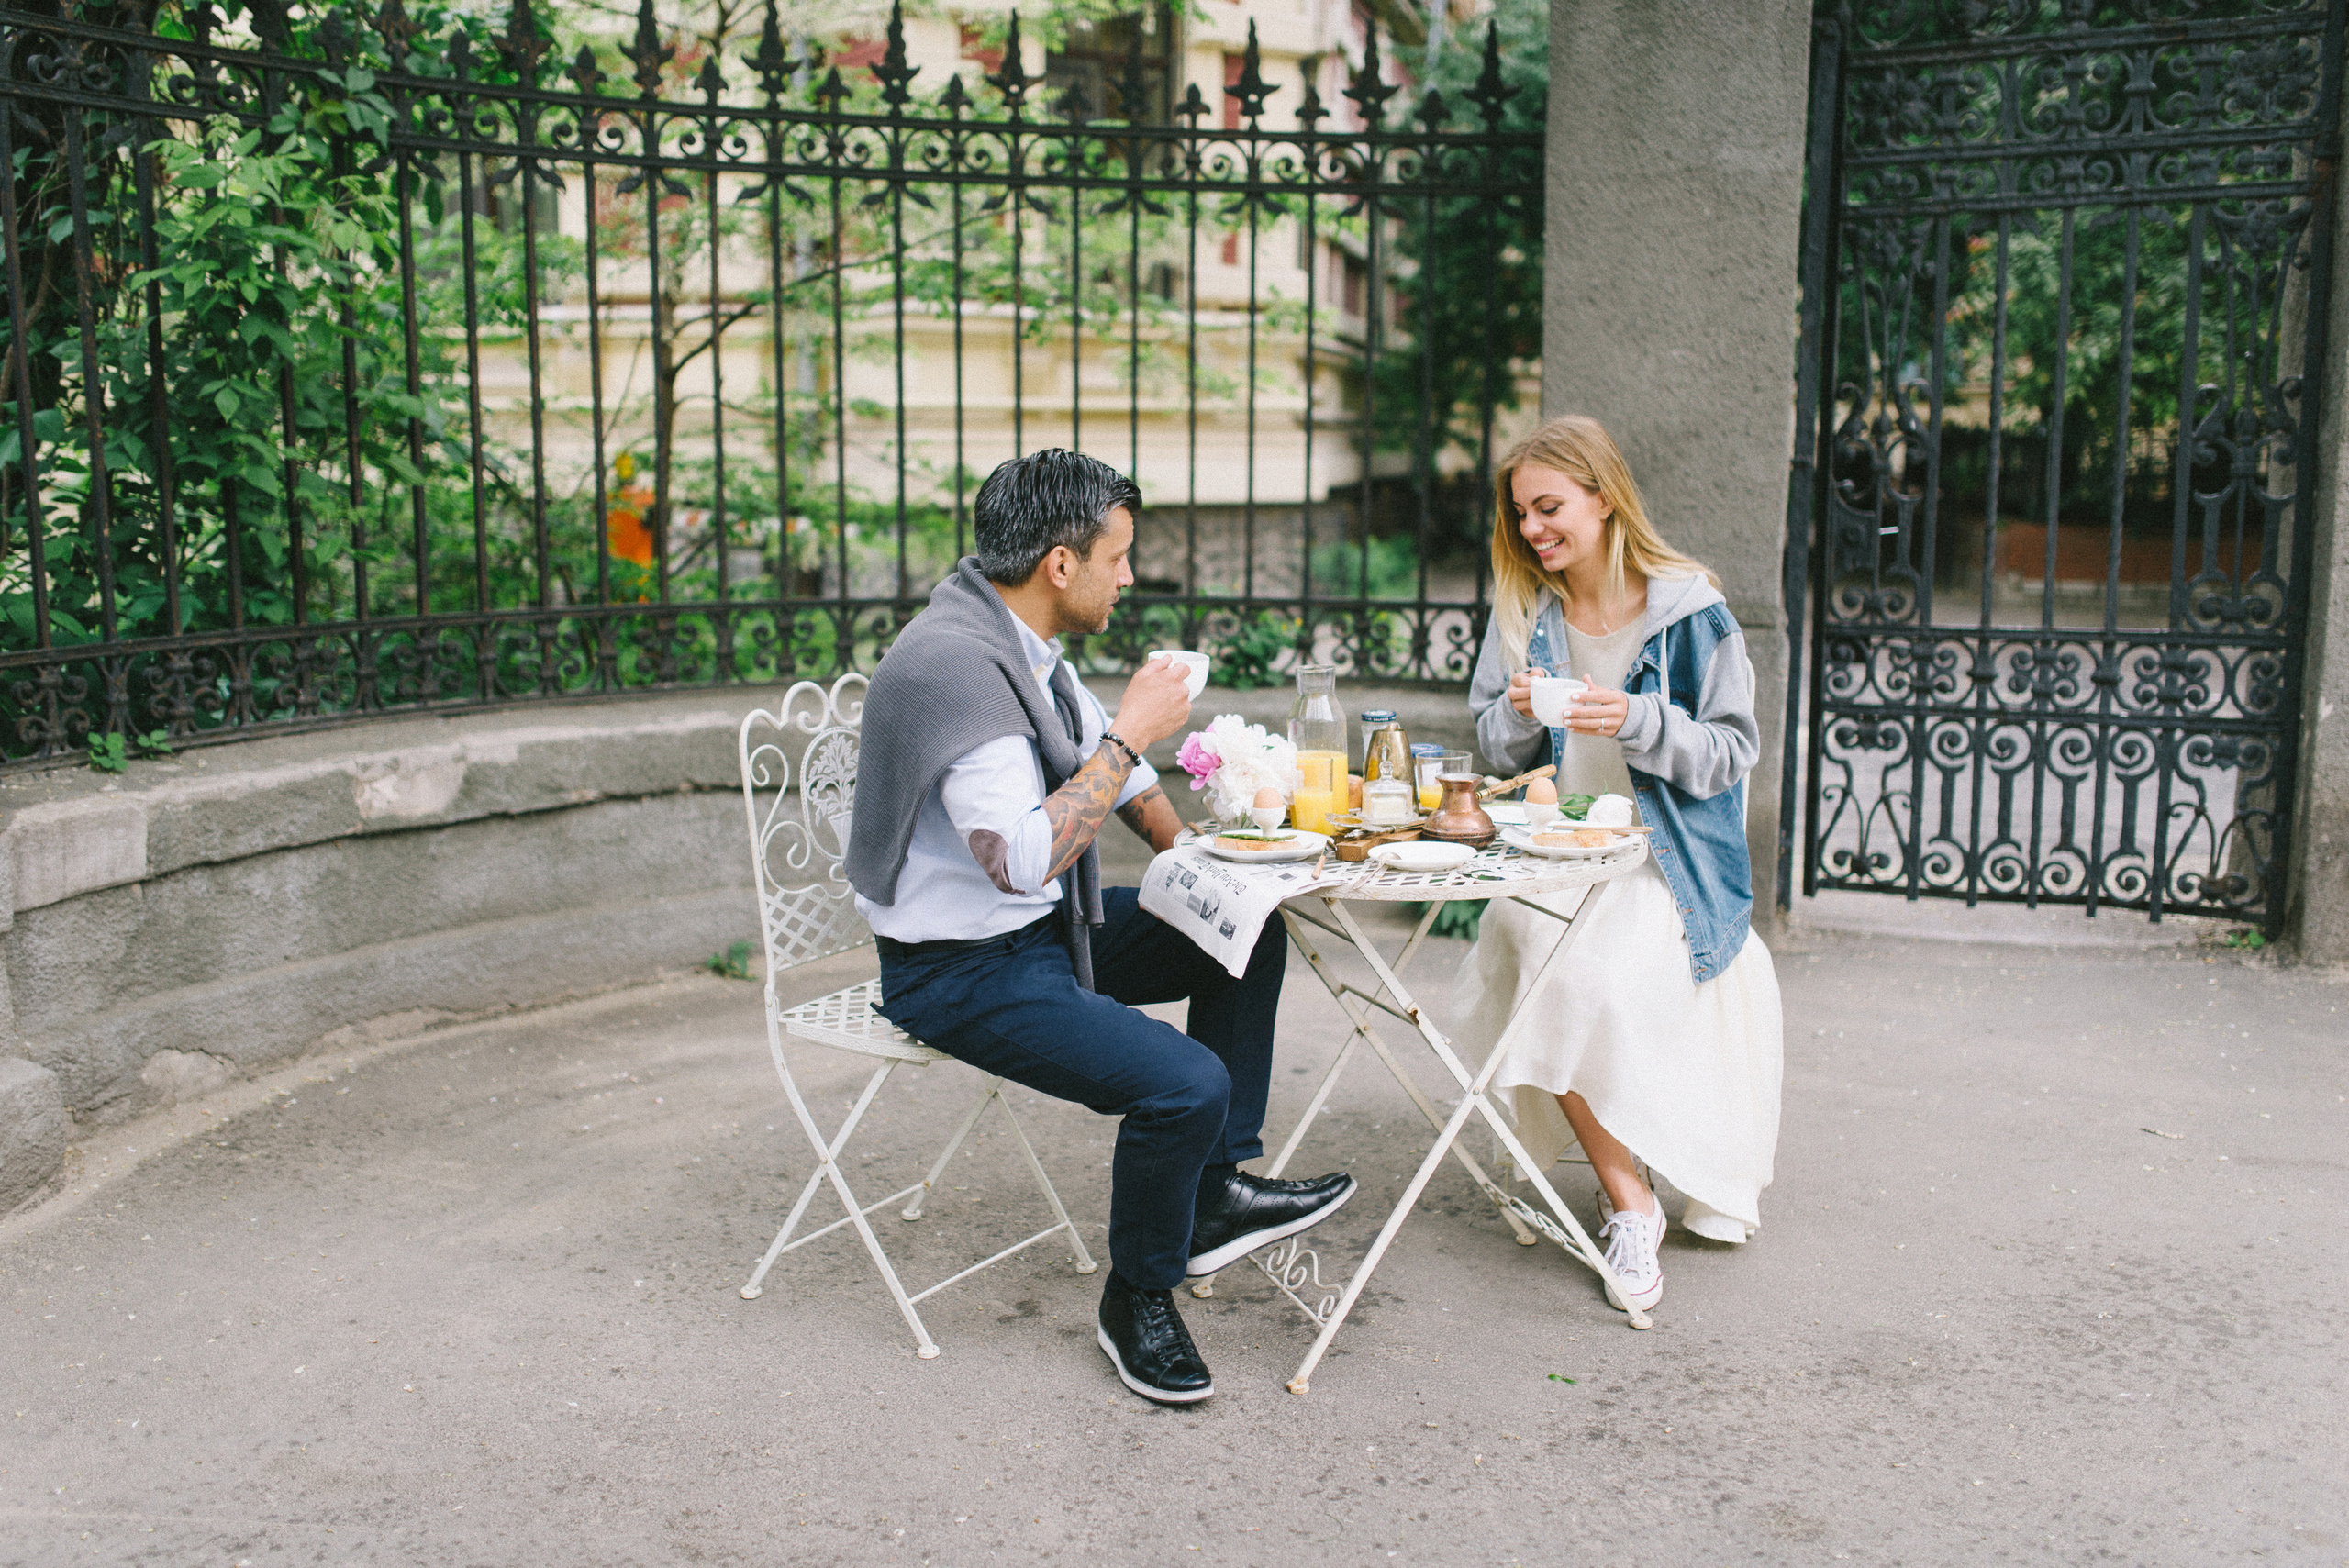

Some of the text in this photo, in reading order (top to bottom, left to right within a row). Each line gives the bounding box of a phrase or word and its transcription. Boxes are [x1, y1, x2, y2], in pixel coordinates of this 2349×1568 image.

[1205, 865, 1228, 879] York
[1220, 873, 1235, 887] New
[1232, 880, 1247, 895] The
